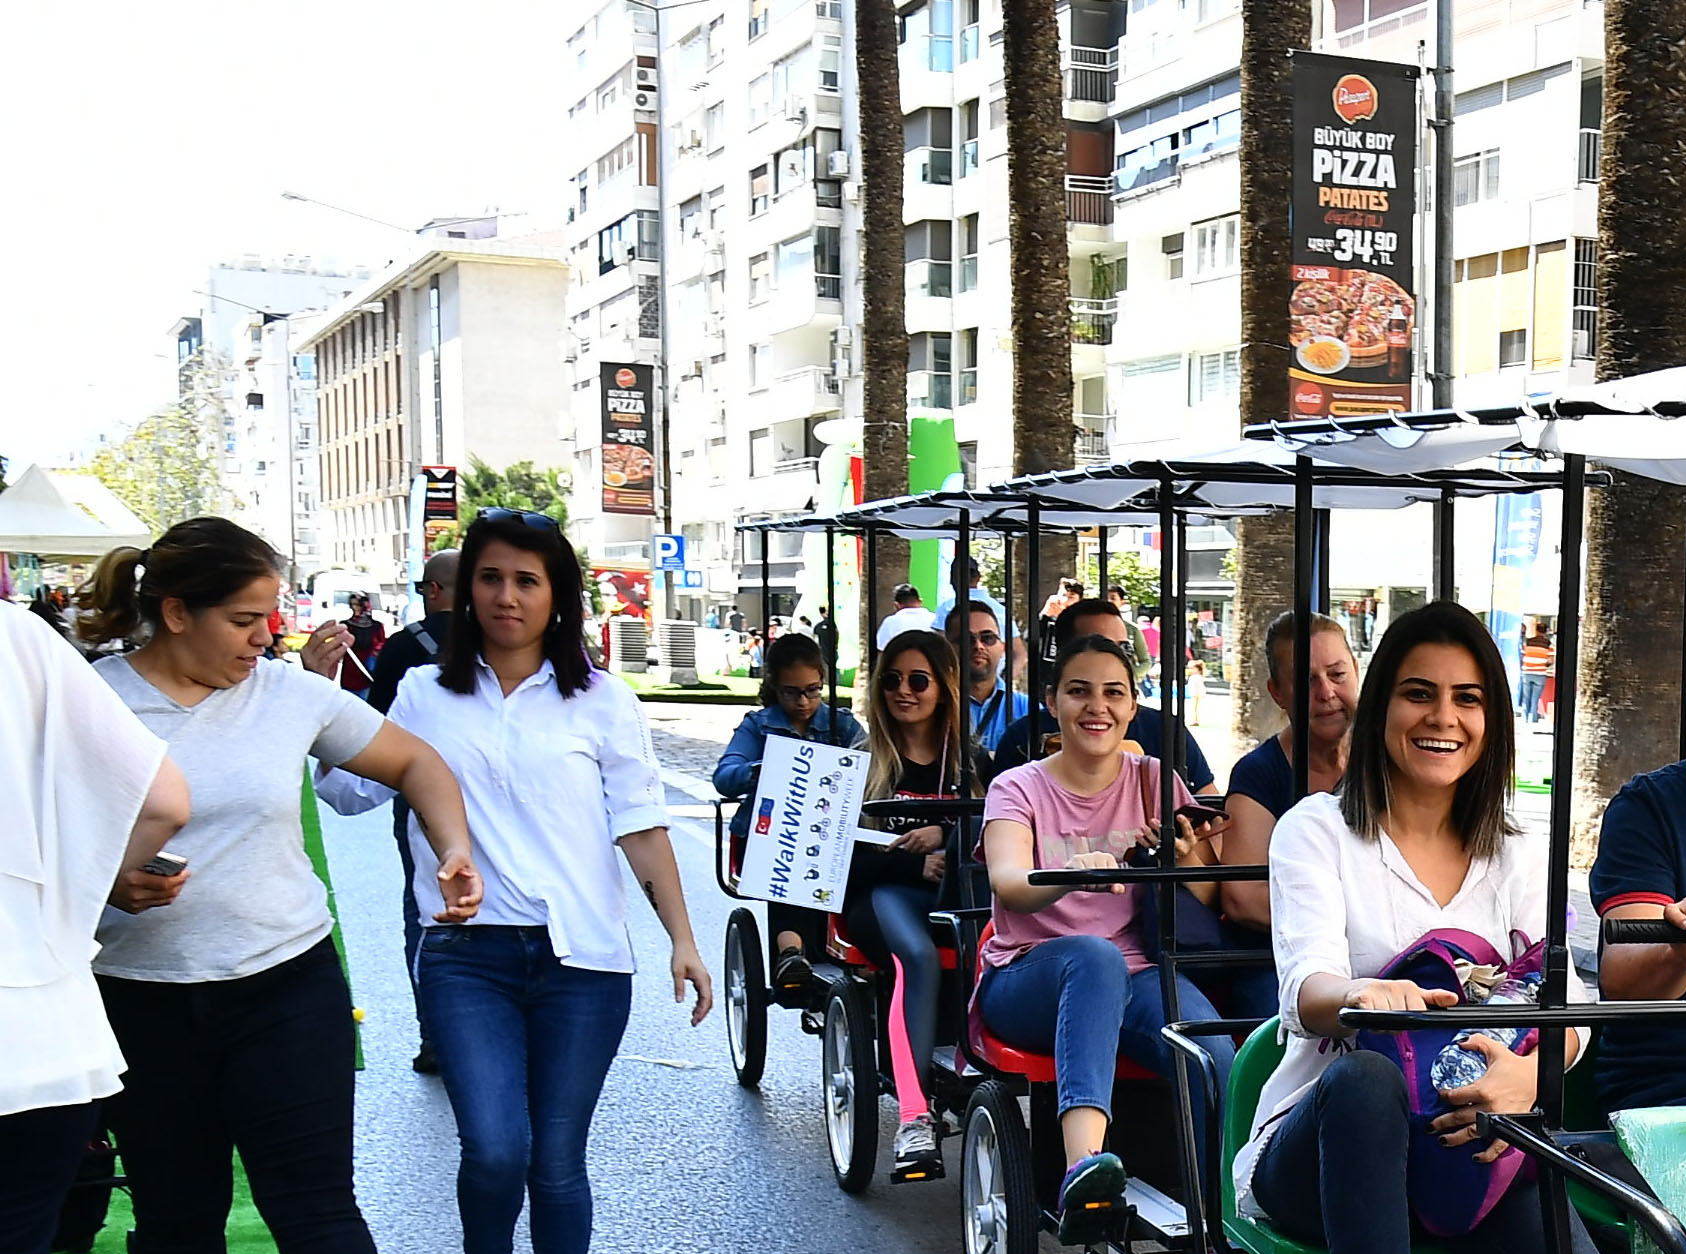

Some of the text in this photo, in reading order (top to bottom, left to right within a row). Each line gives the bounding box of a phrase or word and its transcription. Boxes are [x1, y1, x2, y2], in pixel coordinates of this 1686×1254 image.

[1313, 126, 1395, 151] BÜYÜK BOY
[1318, 186, 1390, 212] PATATES
[655, 536, 679, 568] P
[768, 745, 815, 899] #WalkWithUs
